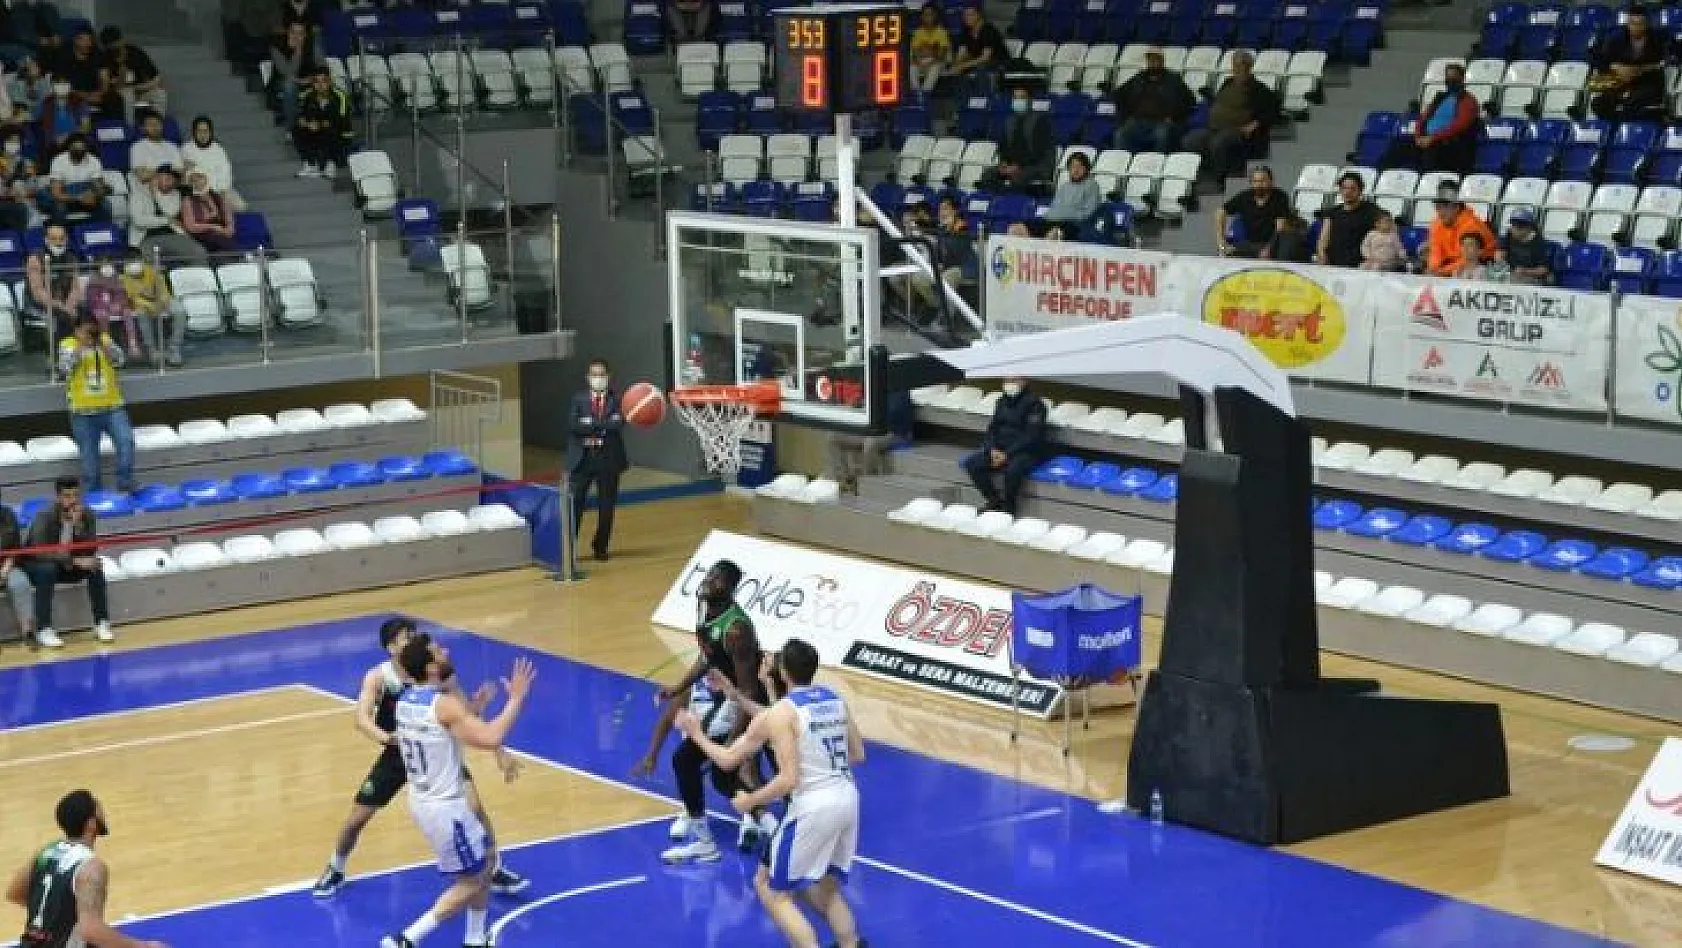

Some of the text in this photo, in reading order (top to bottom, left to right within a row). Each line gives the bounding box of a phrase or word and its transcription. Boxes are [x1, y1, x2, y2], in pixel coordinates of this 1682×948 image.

[1016, 248, 1157, 298] HIRÇIN PEN
[1477, 317, 1543, 343] GRUP
[1078, 626, 1133, 651] molten
[855, 646, 904, 671] İNŞAAT
[917, 663, 954, 683] SERA
[952, 670, 1047, 705] MALZEMEERİ
[402, 737, 429, 775] 21
